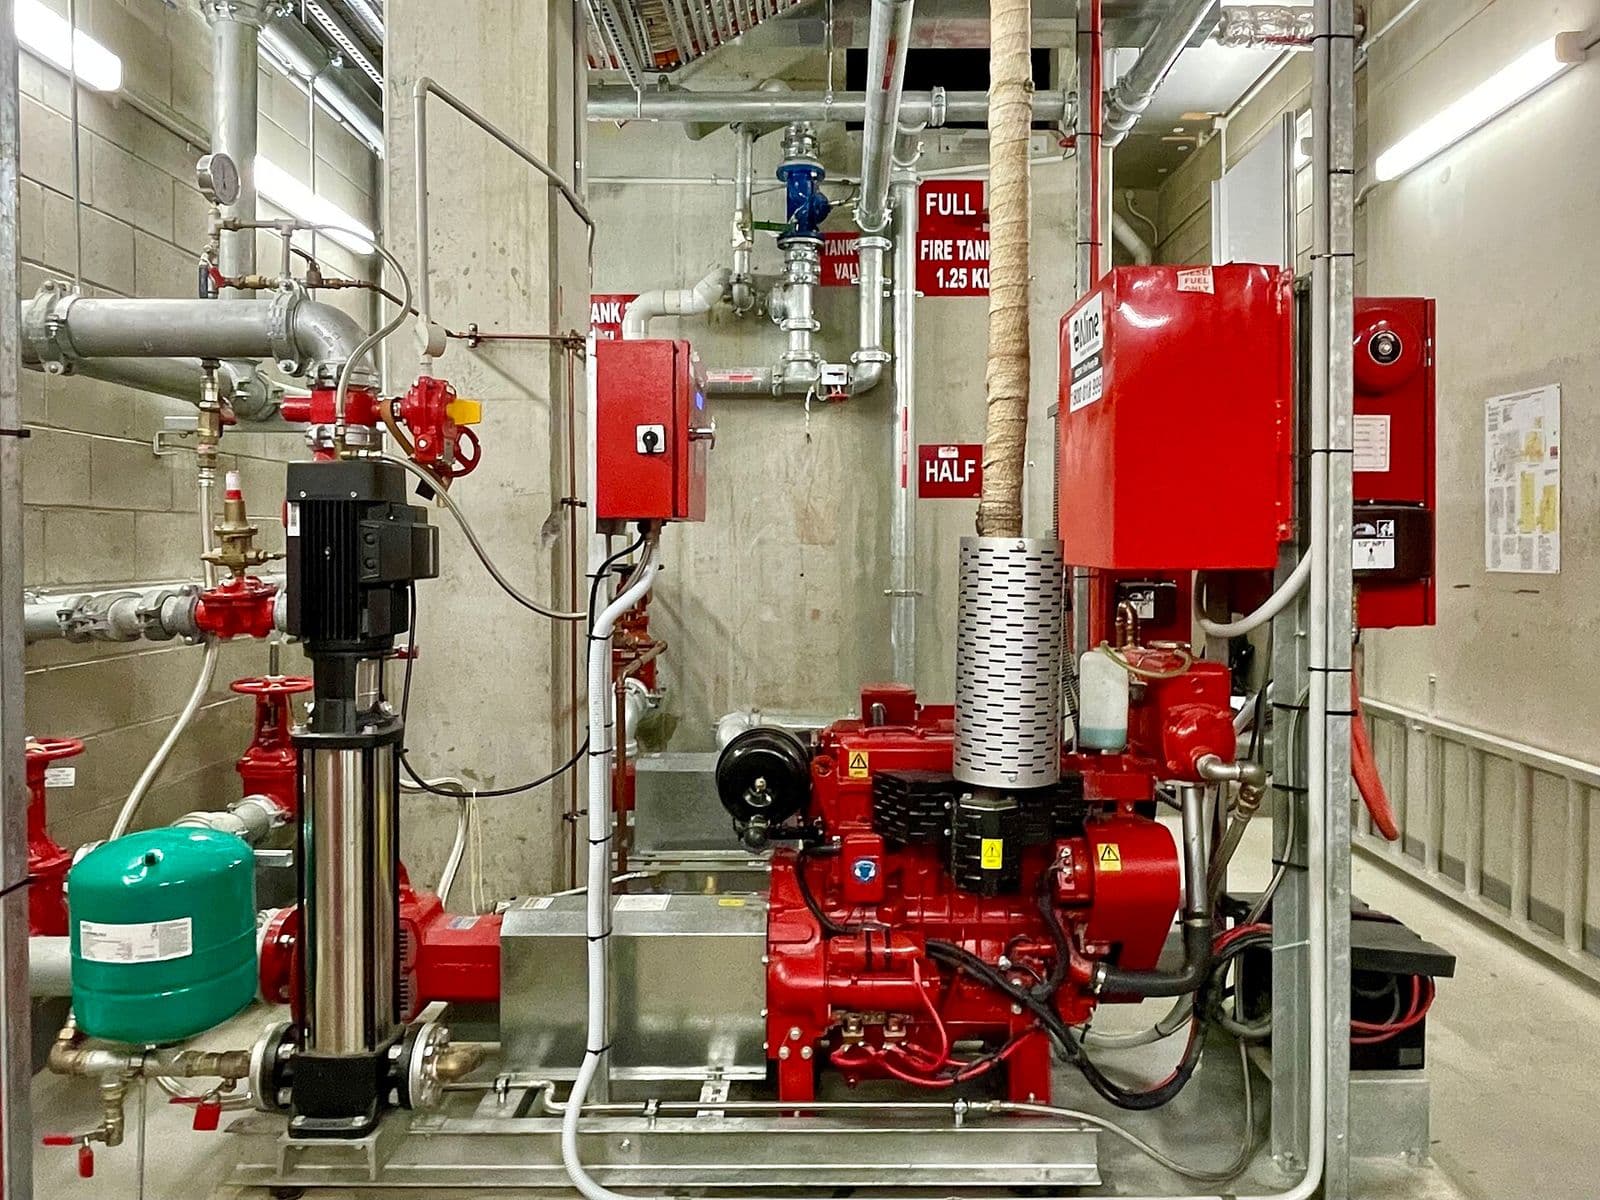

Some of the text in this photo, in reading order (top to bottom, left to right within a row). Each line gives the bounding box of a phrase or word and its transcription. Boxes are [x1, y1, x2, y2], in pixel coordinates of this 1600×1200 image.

[926, 193, 976, 216] FULL
[824, 239, 854, 256] TANK
[920, 239, 953, 261] FIRE
[936, 267, 968, 289] 1.25
[590, 302, 621, 323] ANK
[925, 459, 976, 483] HALF
